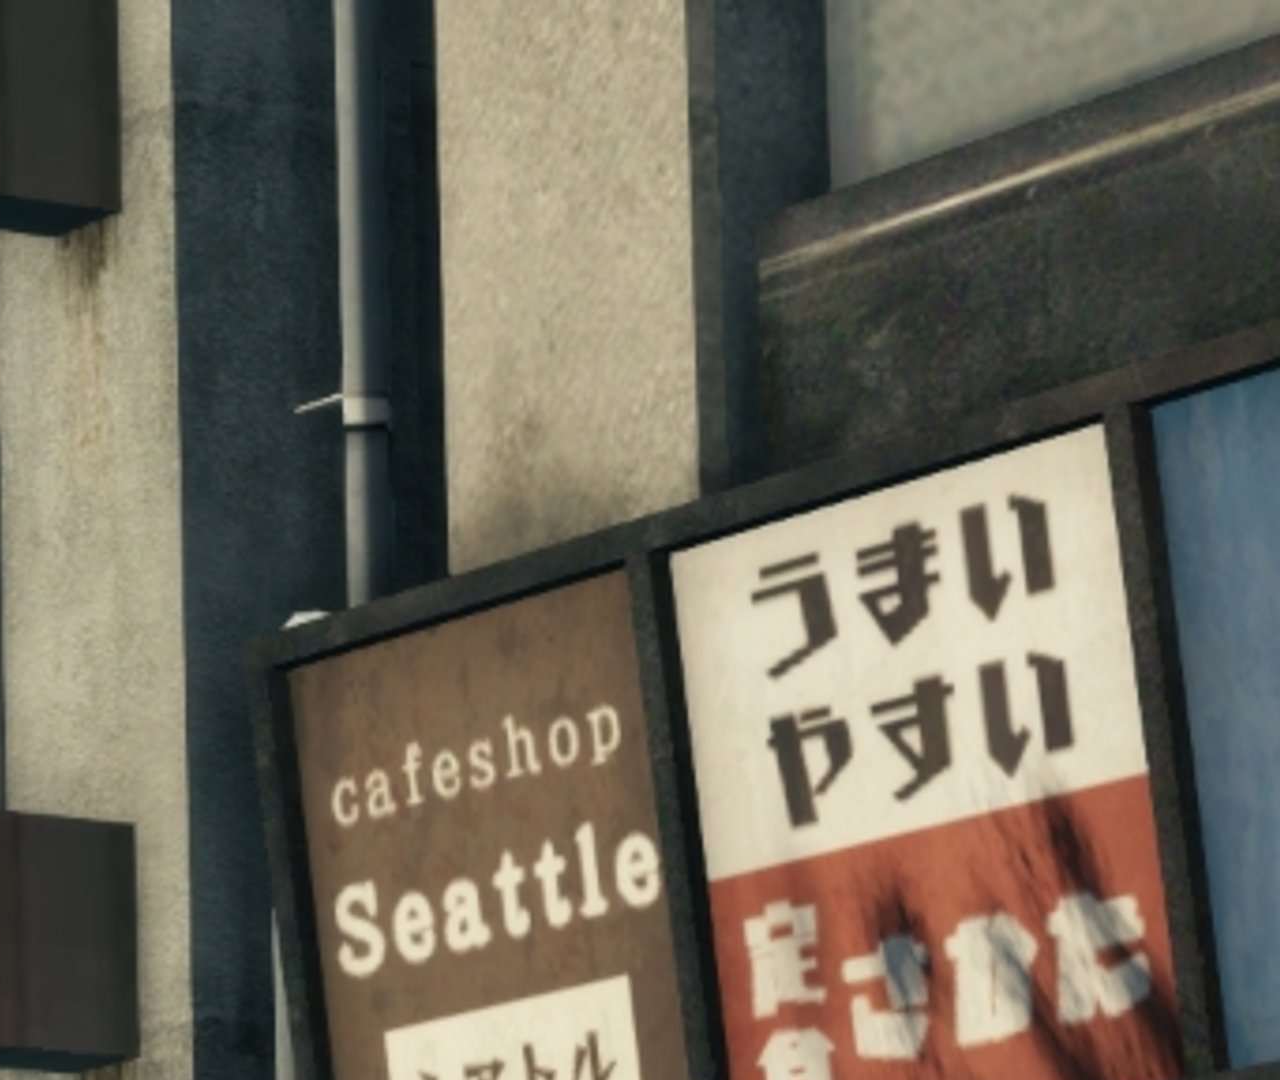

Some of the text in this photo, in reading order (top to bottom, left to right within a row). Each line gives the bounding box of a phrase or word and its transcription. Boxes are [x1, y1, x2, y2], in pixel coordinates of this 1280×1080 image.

[750, 493, 1056, 680] うまい
[331, 704, 622, 827] cafeshop
[767, 650, 1075, 829] やすい
[335, 821, 661, 978] Seattle
